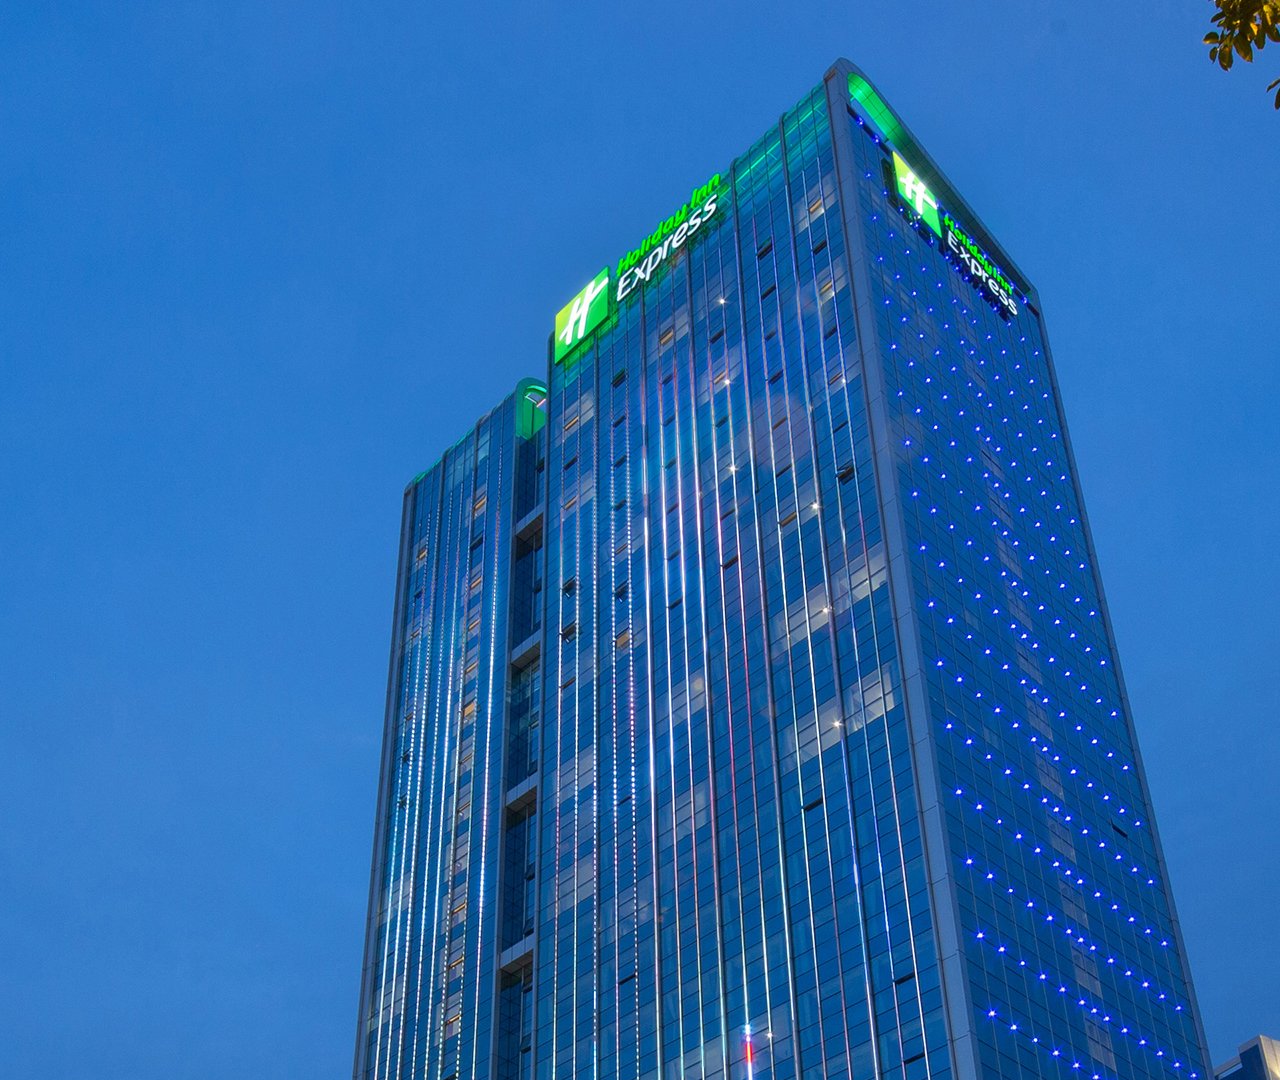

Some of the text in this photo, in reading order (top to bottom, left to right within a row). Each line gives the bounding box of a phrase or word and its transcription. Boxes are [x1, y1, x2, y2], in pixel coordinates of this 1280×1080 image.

[617, 173, 721, 277] Holiday Inn
[617, 194, 718, 302] Express
[943, 215, 1013, 296] Holiday Inn
[947, 230, 1018, 316] Express
